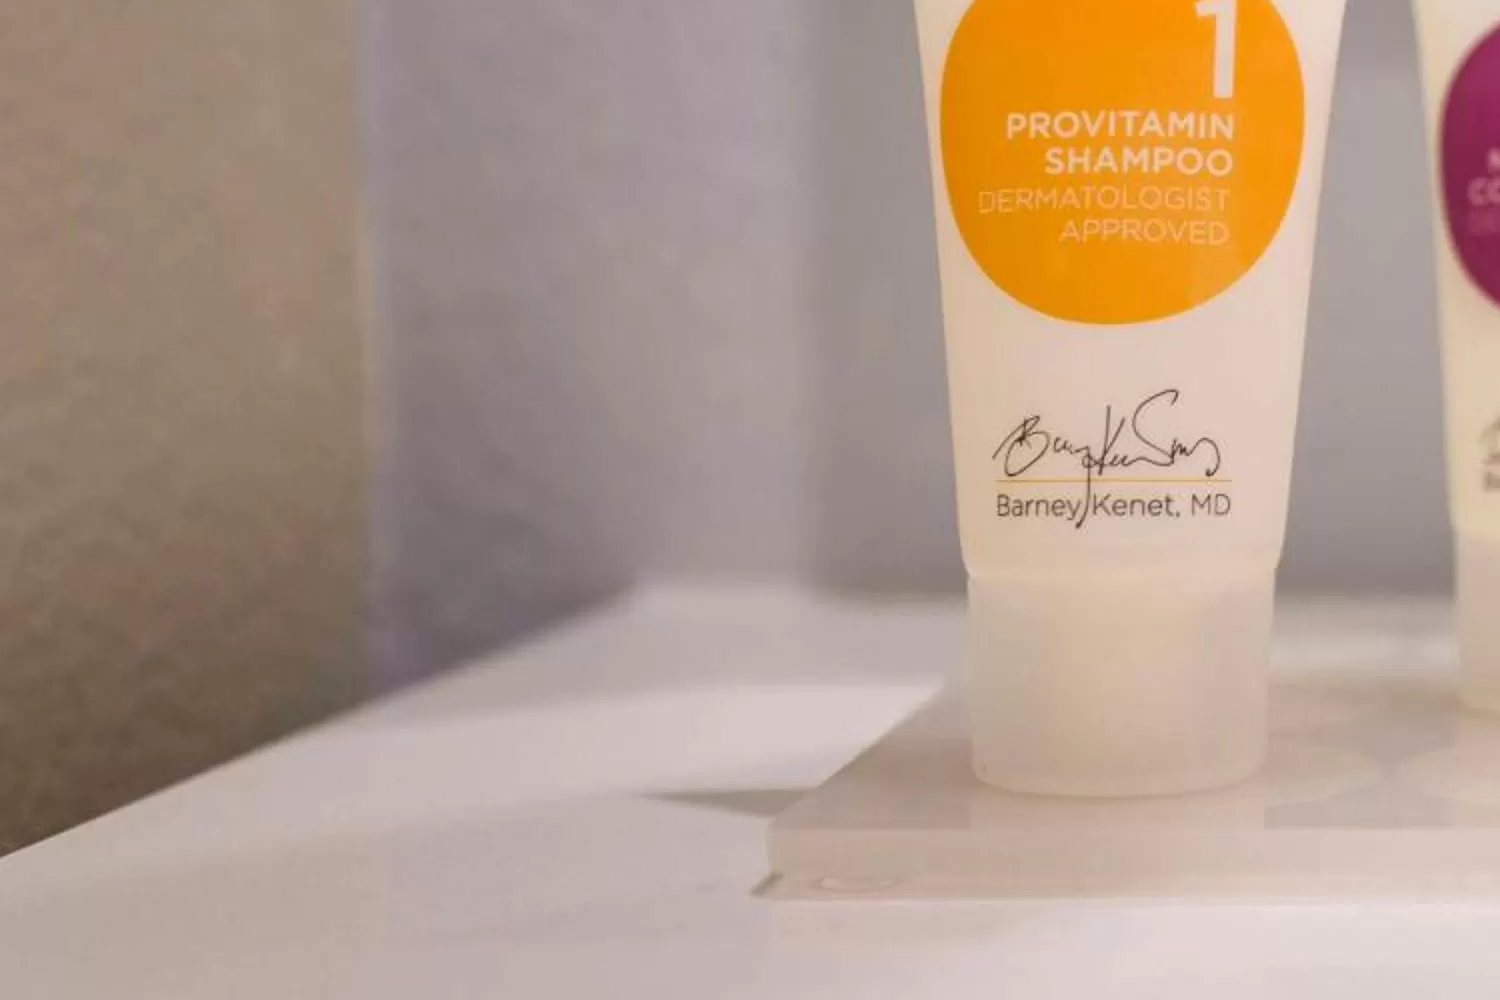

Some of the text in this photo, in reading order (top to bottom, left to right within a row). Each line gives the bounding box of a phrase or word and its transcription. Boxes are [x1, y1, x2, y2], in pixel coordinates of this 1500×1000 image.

[1006, 110, 1234, 141] PROVITAMIN
[1045, 147, 1233, 177] SHAMPOO
[977, 185, 1231, 215] DERMATOLOGIST
[1059, 218, 1231, 247] APPROVED
[996, 493, 1232, 521] Barney Kenet, MD
